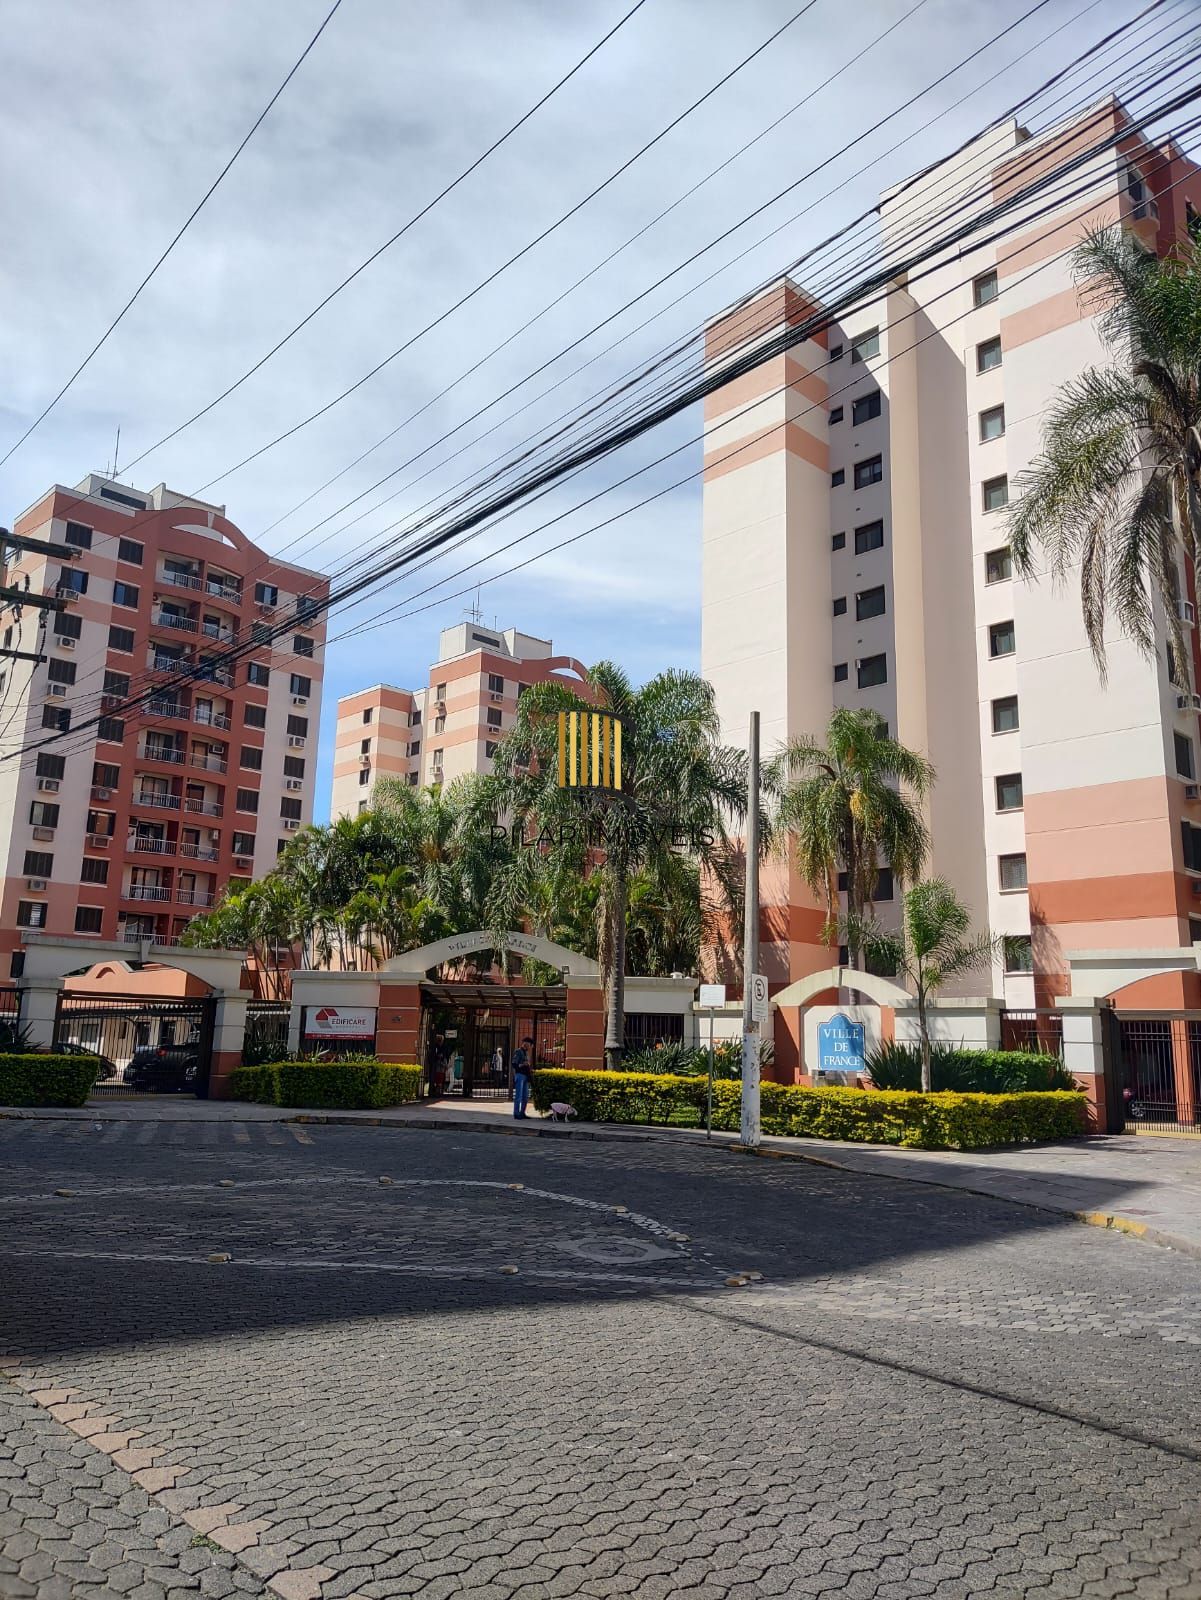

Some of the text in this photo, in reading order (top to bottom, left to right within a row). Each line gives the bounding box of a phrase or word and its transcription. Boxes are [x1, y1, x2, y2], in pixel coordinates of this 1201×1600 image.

[331, 1018, 366, 1026] EDIFICARE
[823, 1028, 859, 1039] VILLE
[834, 1042, 849, 1052] DE
[824, 1055, 860, 1066] FRANCE
